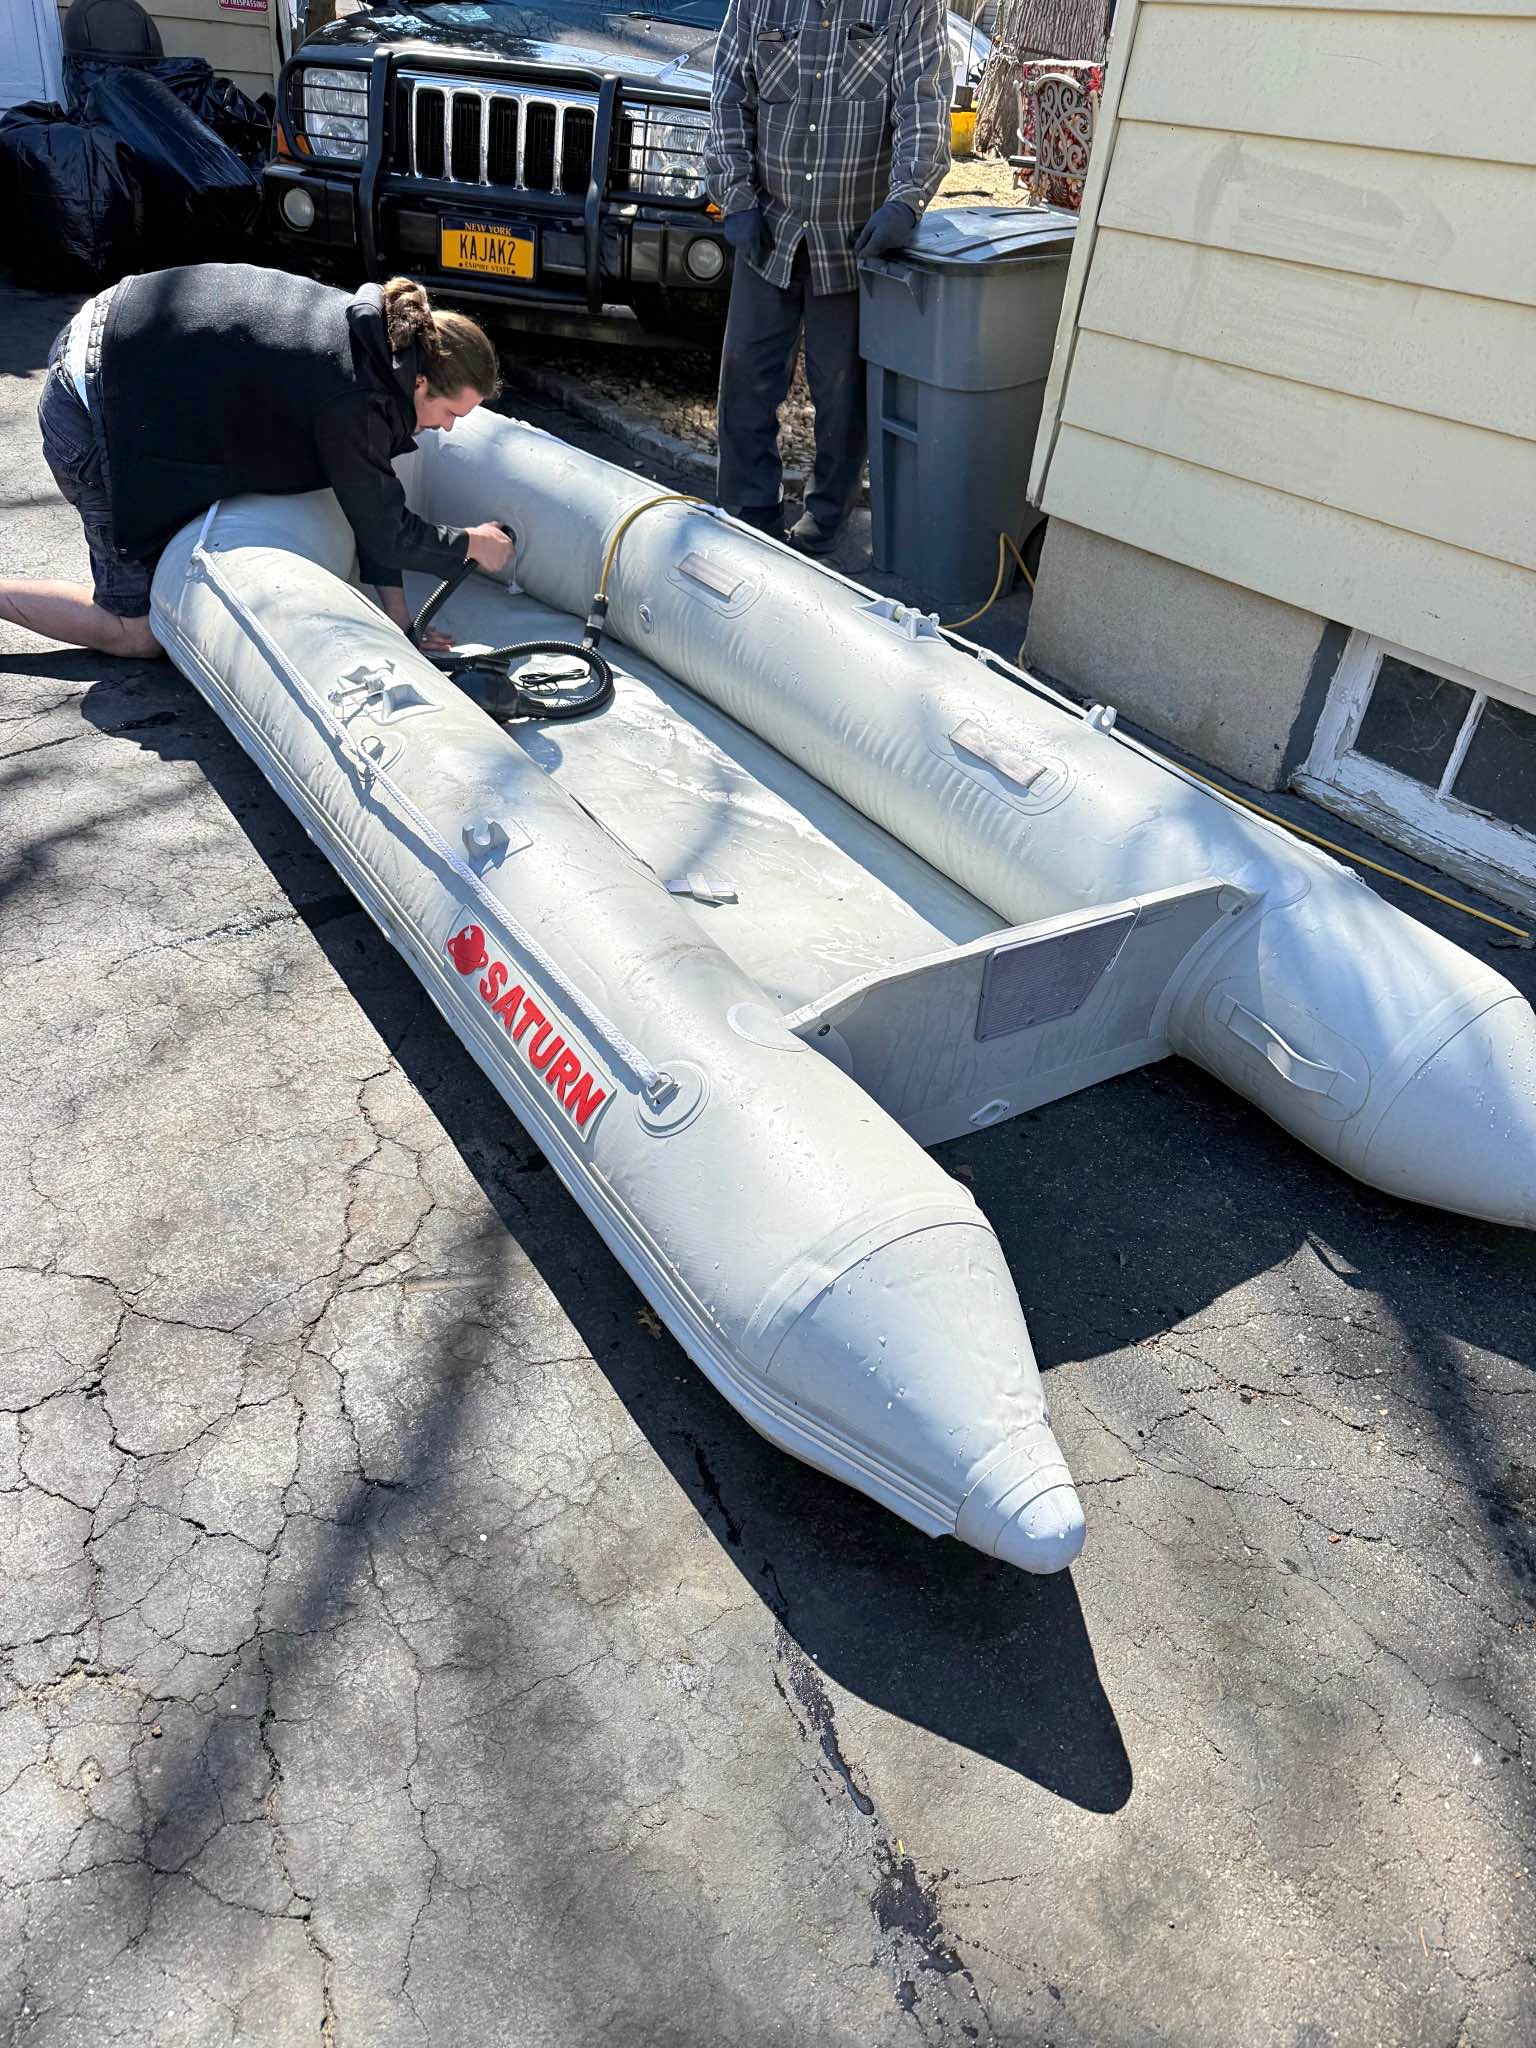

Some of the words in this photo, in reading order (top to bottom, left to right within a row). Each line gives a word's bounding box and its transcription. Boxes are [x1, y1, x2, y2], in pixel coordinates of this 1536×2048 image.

[464, 222, 487, 232] NEW
[488, 225, 512, 237] YORK
[459, 233, 516, 266] KAJAK2
[464, 261, 488, 271] EMPIRE
[490, 264, 511, 274] STATE
[479, 961, 607, 1127] SATURN
